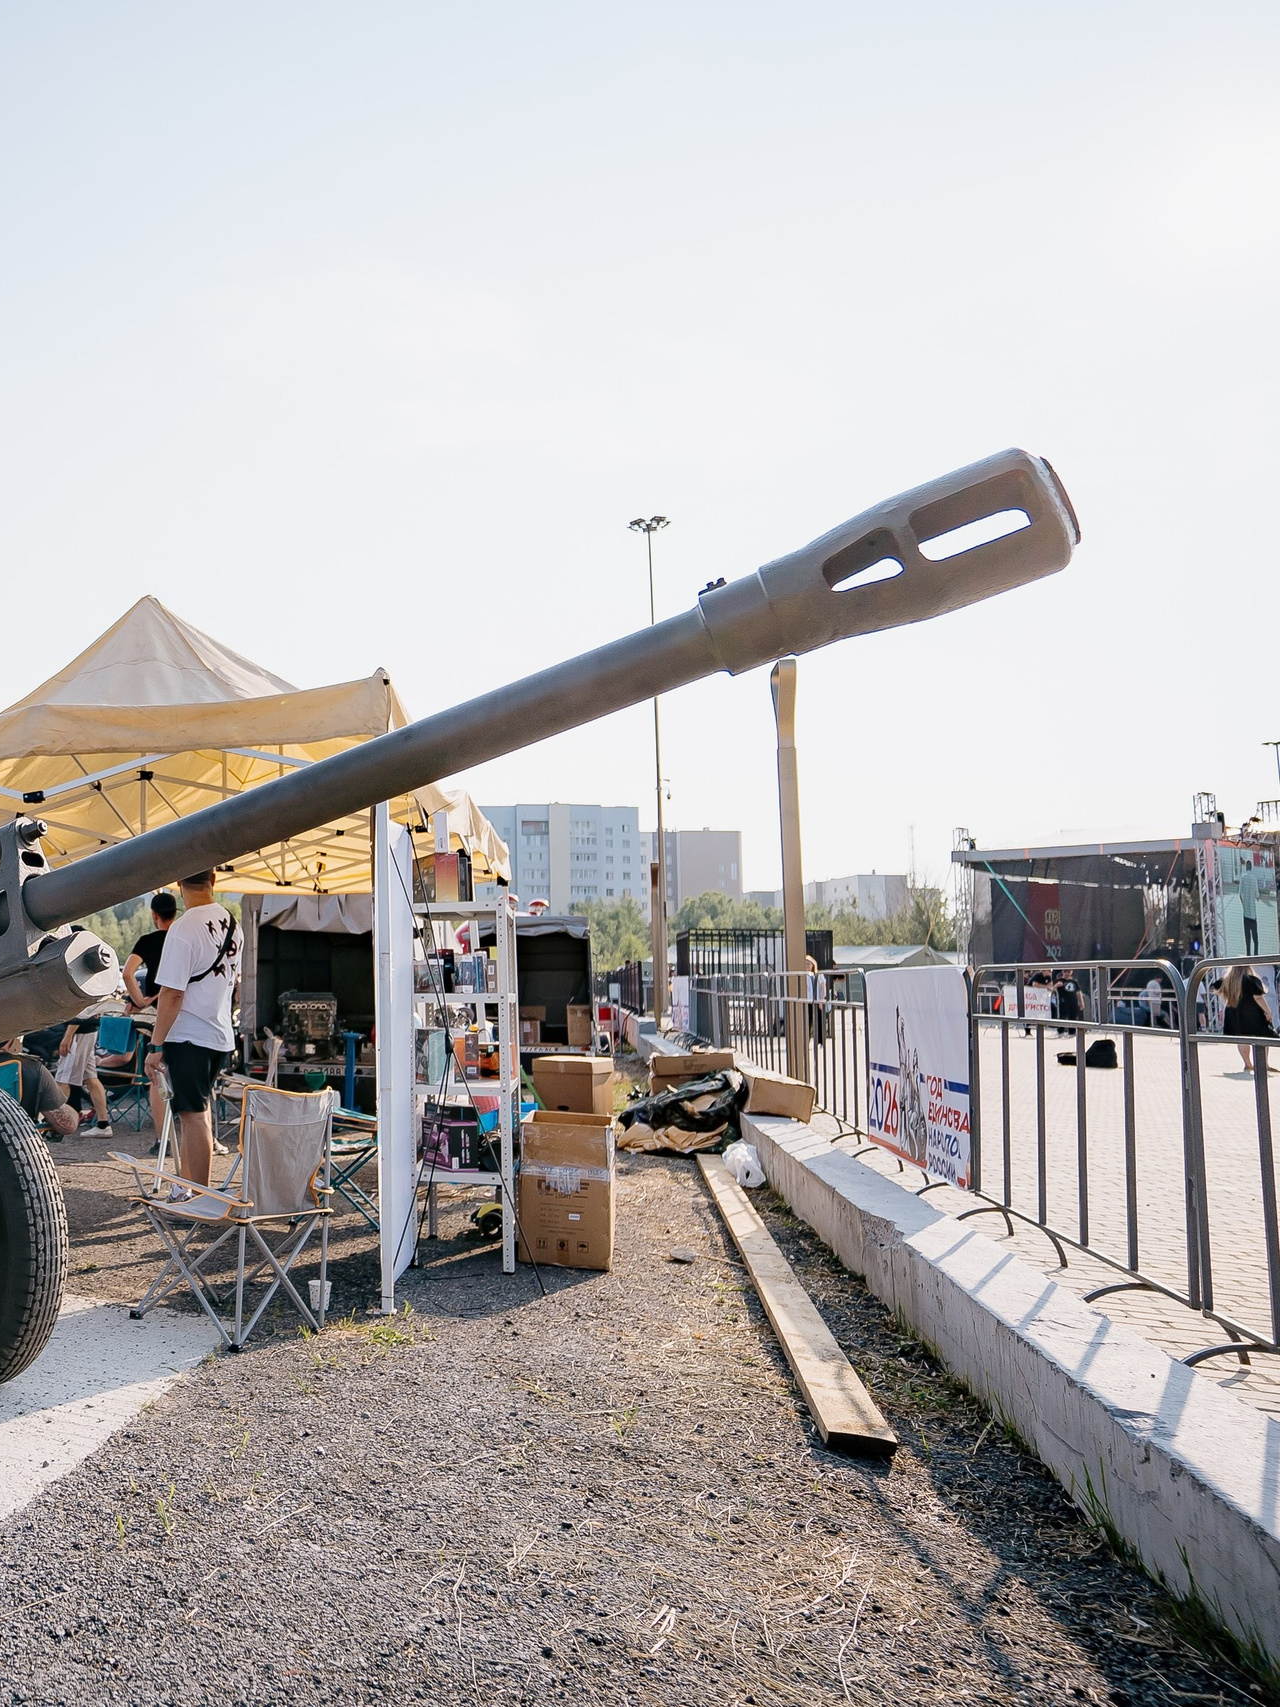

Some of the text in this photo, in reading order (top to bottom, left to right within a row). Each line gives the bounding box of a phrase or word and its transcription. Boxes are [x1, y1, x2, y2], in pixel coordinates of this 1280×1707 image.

[926, 1075, 943, 1102] ГОД
[869, 1076, 899, 1138] 2026
[928, 1127, 962, 1160] НАРОДО
